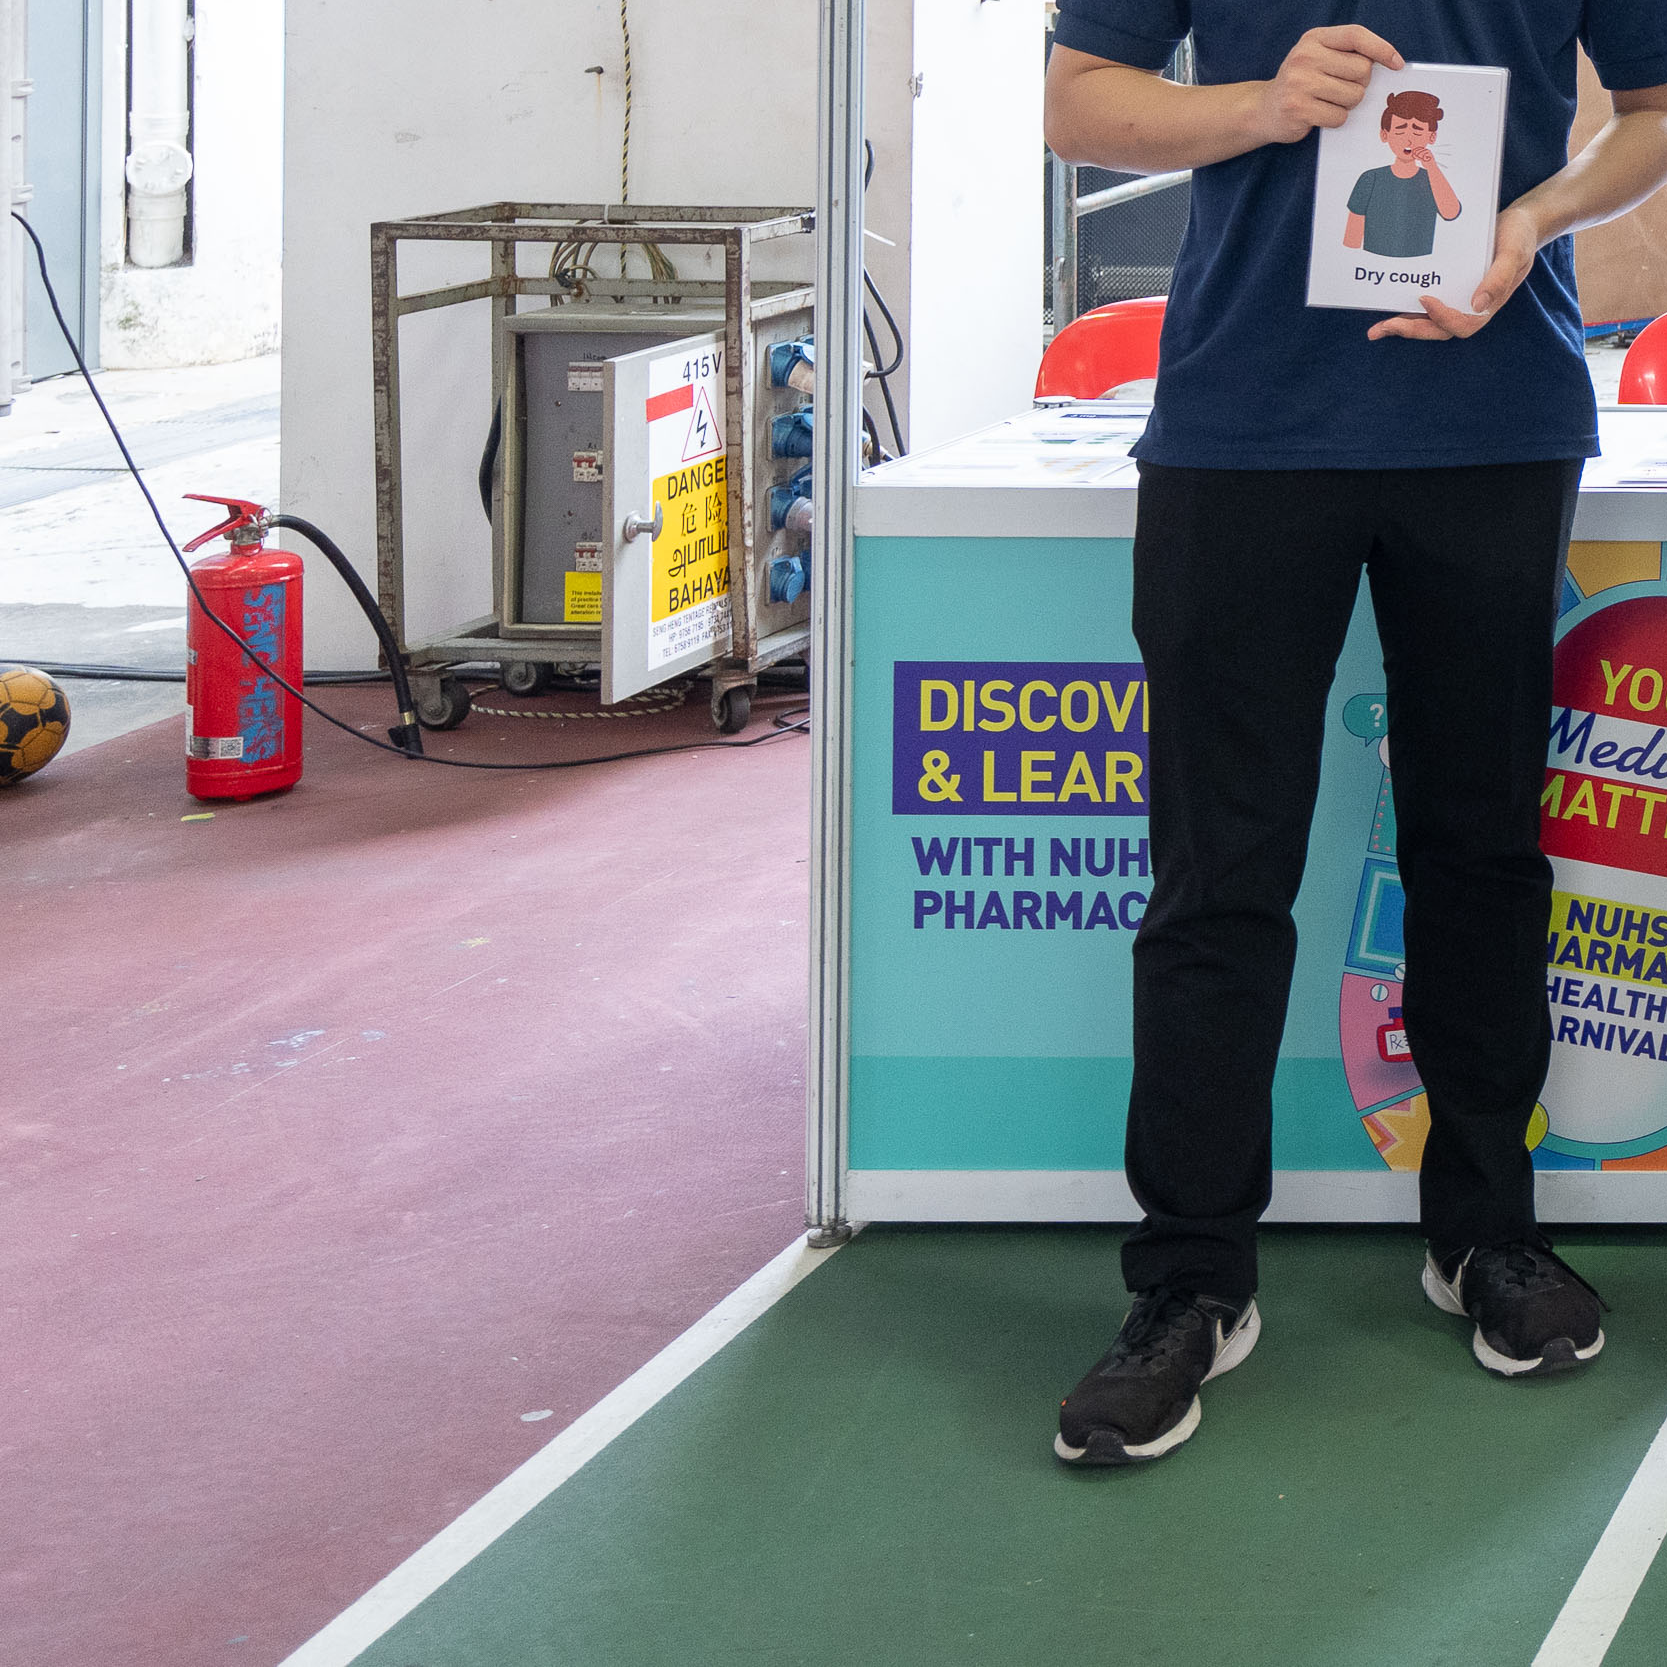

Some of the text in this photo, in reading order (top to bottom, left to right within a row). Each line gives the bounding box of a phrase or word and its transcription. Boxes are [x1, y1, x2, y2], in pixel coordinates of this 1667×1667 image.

[1354, 267, 1442, 288] Dry cough
[667, 458, 728, 500] DANGE
[681, 492, 723, 536] 危险
[919, 679, 1149, 734] DISCOV
[918, 749, 1145, 804] & LEAR
[912, 837, 1151, 878] WITH NUH
[913, 890, 1148, 931] PHARMAC
